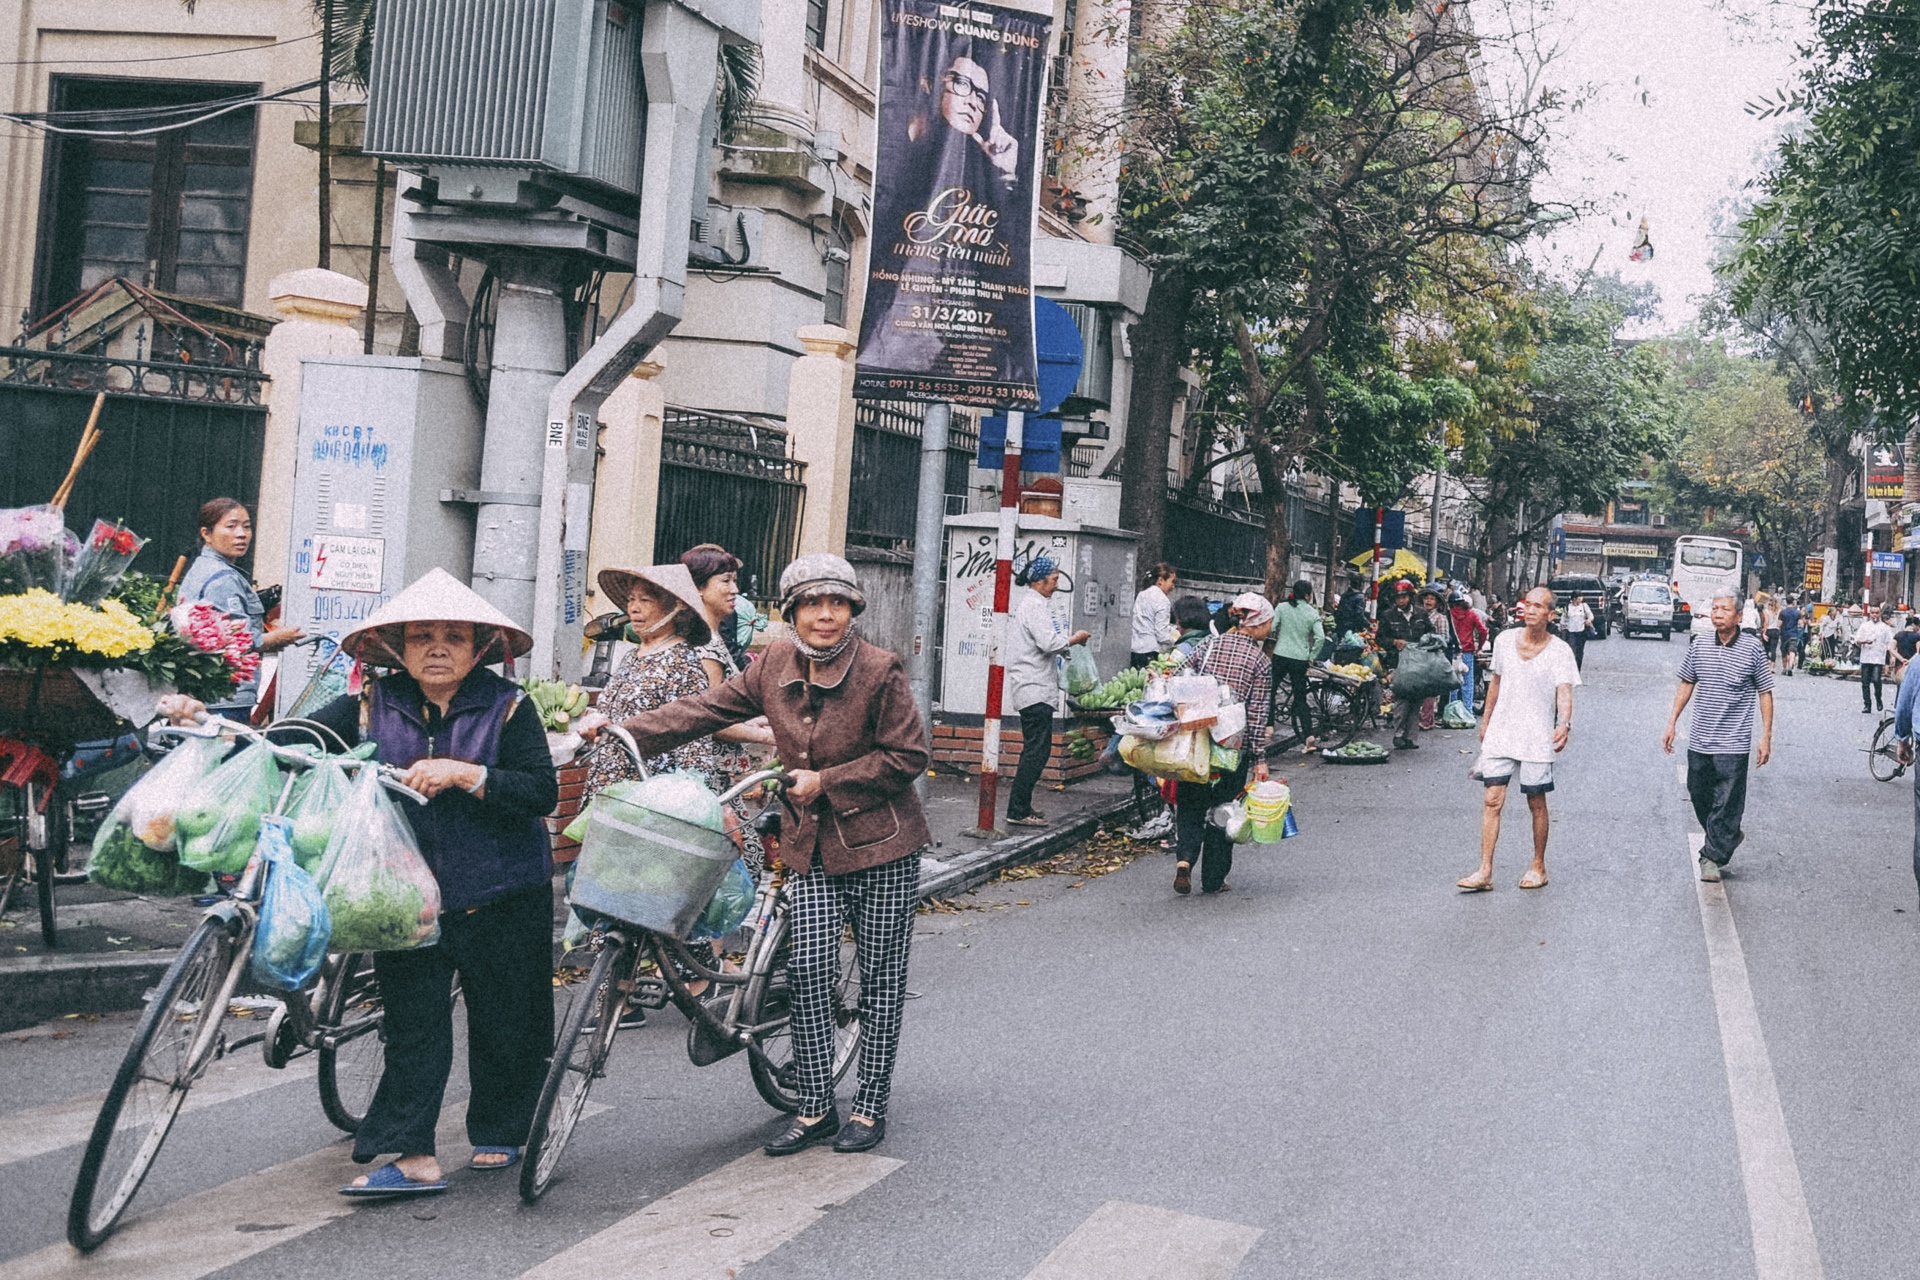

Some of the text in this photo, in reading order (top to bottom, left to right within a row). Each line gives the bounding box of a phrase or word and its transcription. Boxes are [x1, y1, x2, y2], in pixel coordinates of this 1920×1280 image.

[891, 12, 951, 31] LIVESHOW
[954, 22, 1000, 42] QUANG
[901, 273, 934, 285] NHUNG
[895, 320, 917, 328] CUNG
[911, 305, 993, 325] 31/3/2017
[889, 380, 915, 389] 0911
[918, 382, 931, 390] 56
[934, 383, 960, 392] 5533
[968, 385, 993, 395] 0915
[996, 388, 1008, 397] 33
[1011, 389, 1036, 400] 1936
[549, 422, 563, 446] BNE
[981, 607, 994, 617] BN
